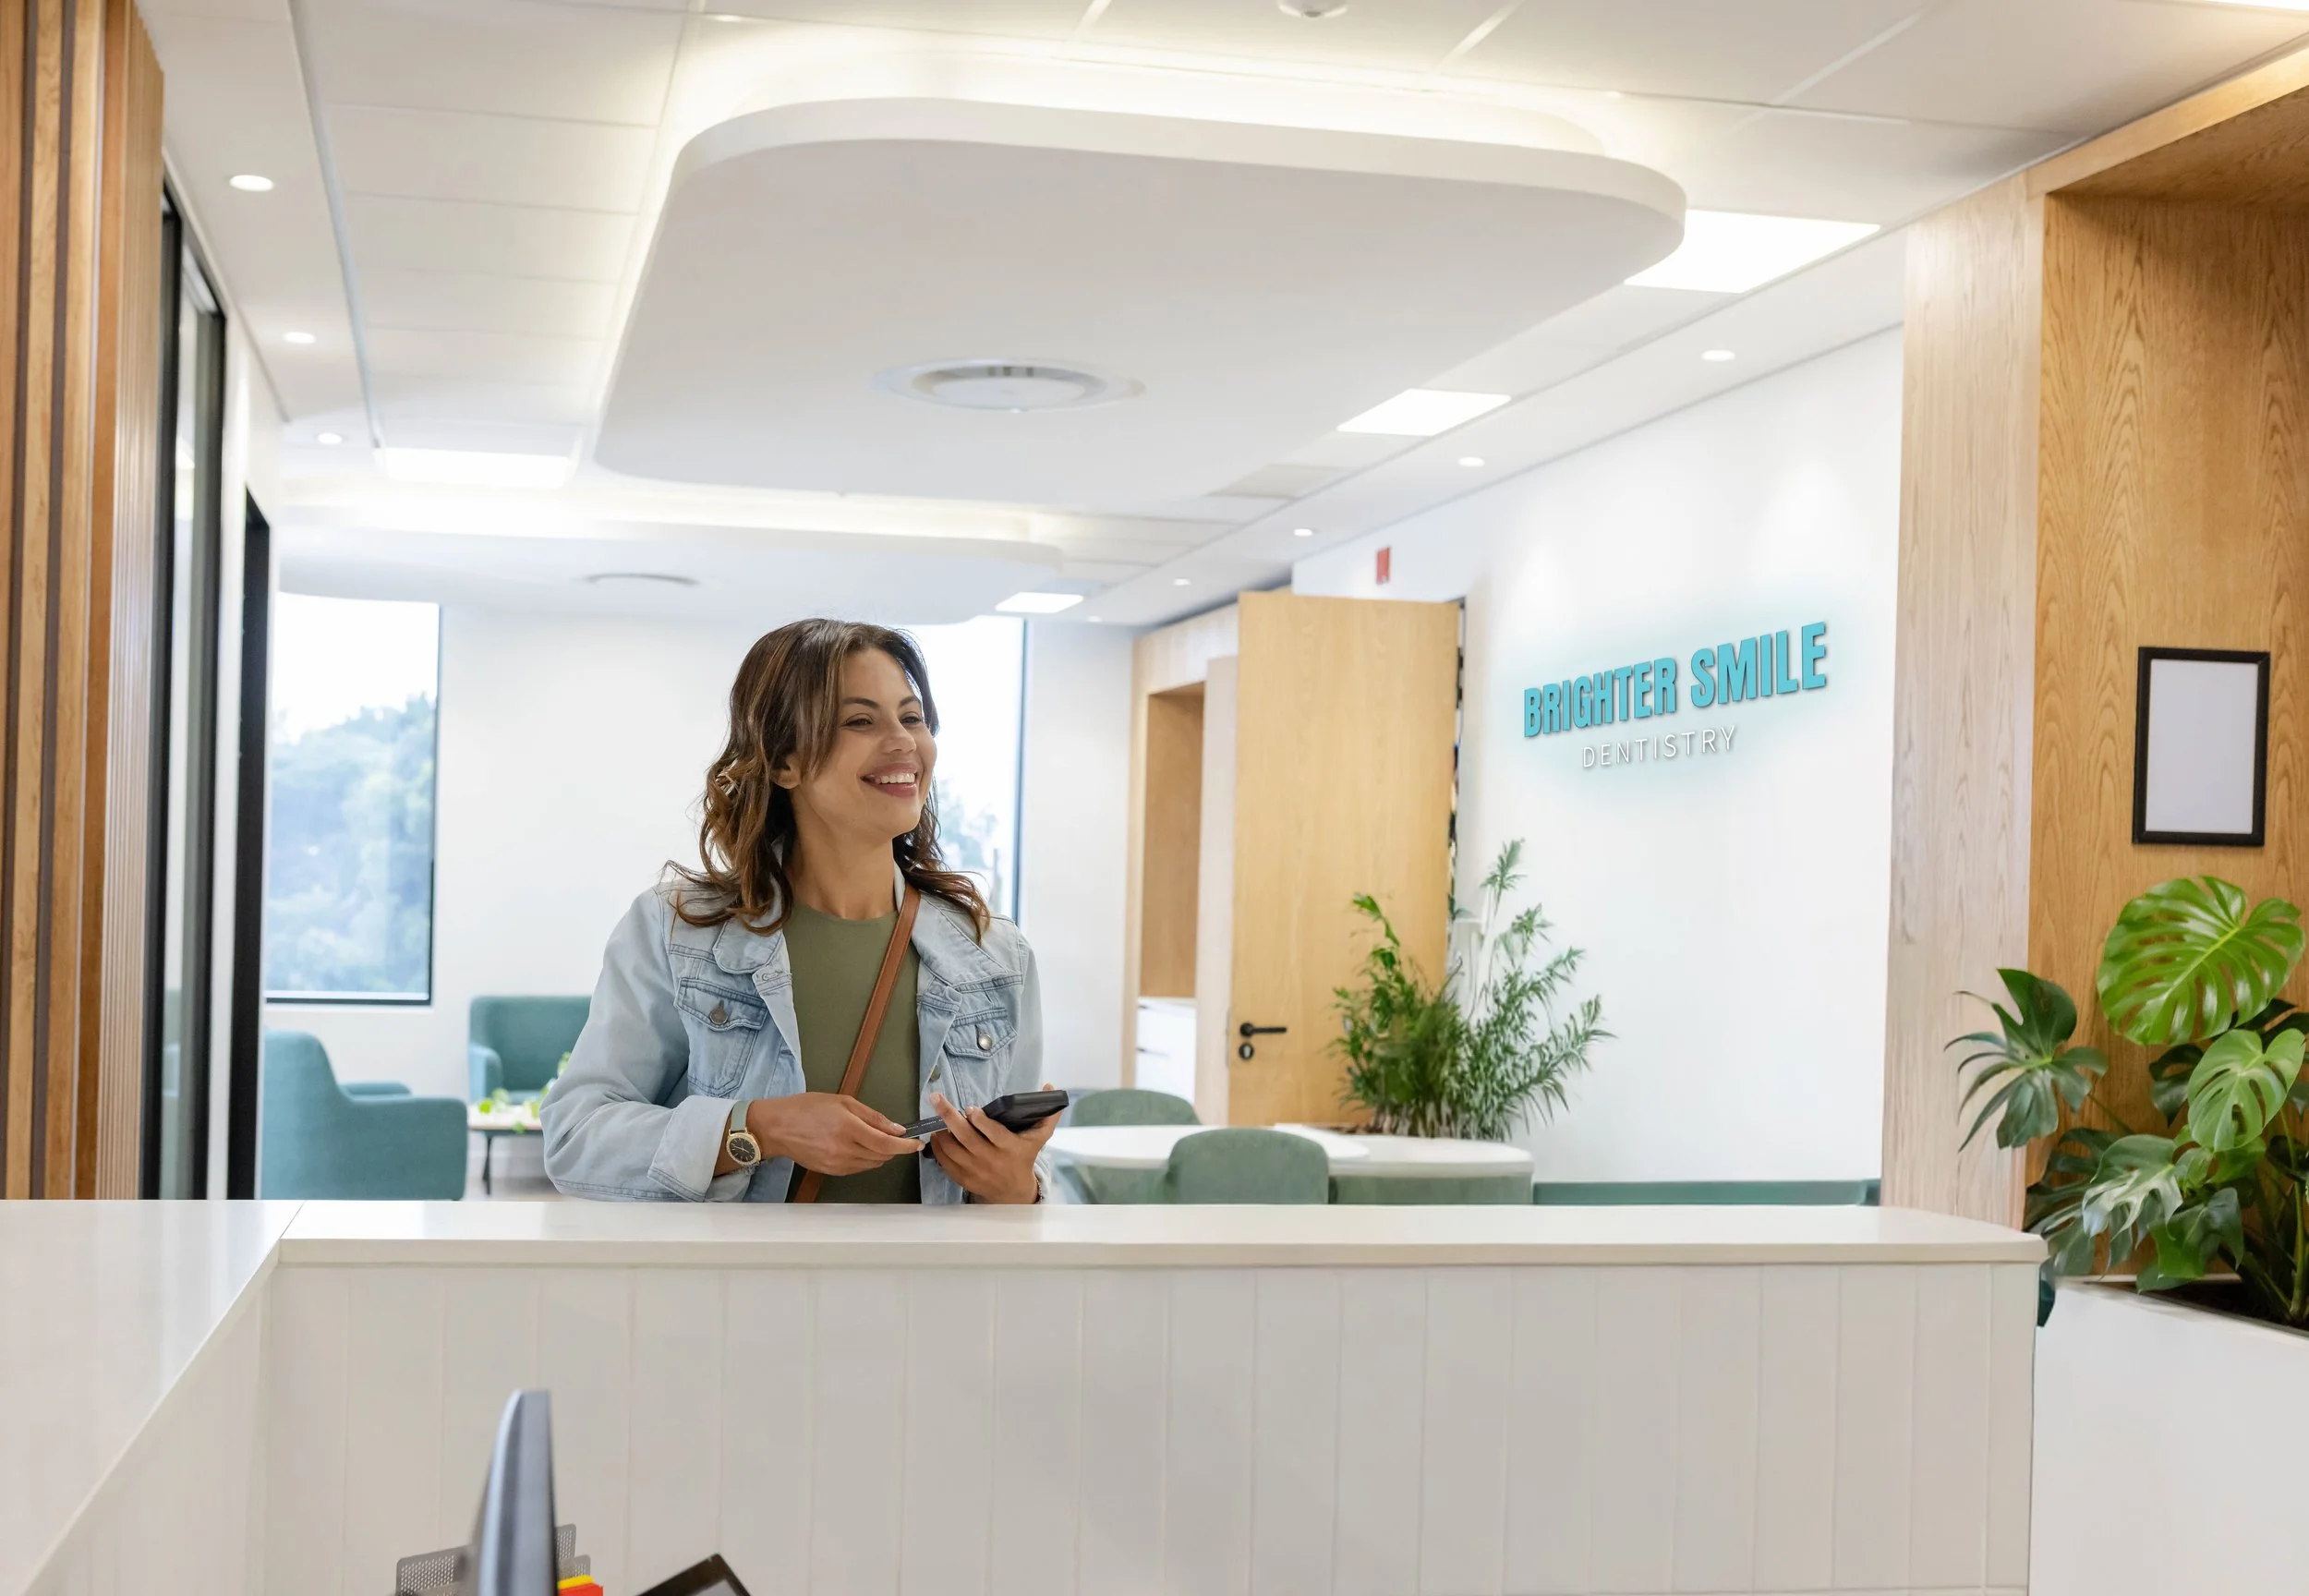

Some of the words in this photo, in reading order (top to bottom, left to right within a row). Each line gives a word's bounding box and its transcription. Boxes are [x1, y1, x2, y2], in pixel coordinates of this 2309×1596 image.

[1524, 657, 1677, 738] BRIGHTER
[1690, 622, 1826, 708] SMILE
[1583, 725, 1736, 768] DENTISTRY
